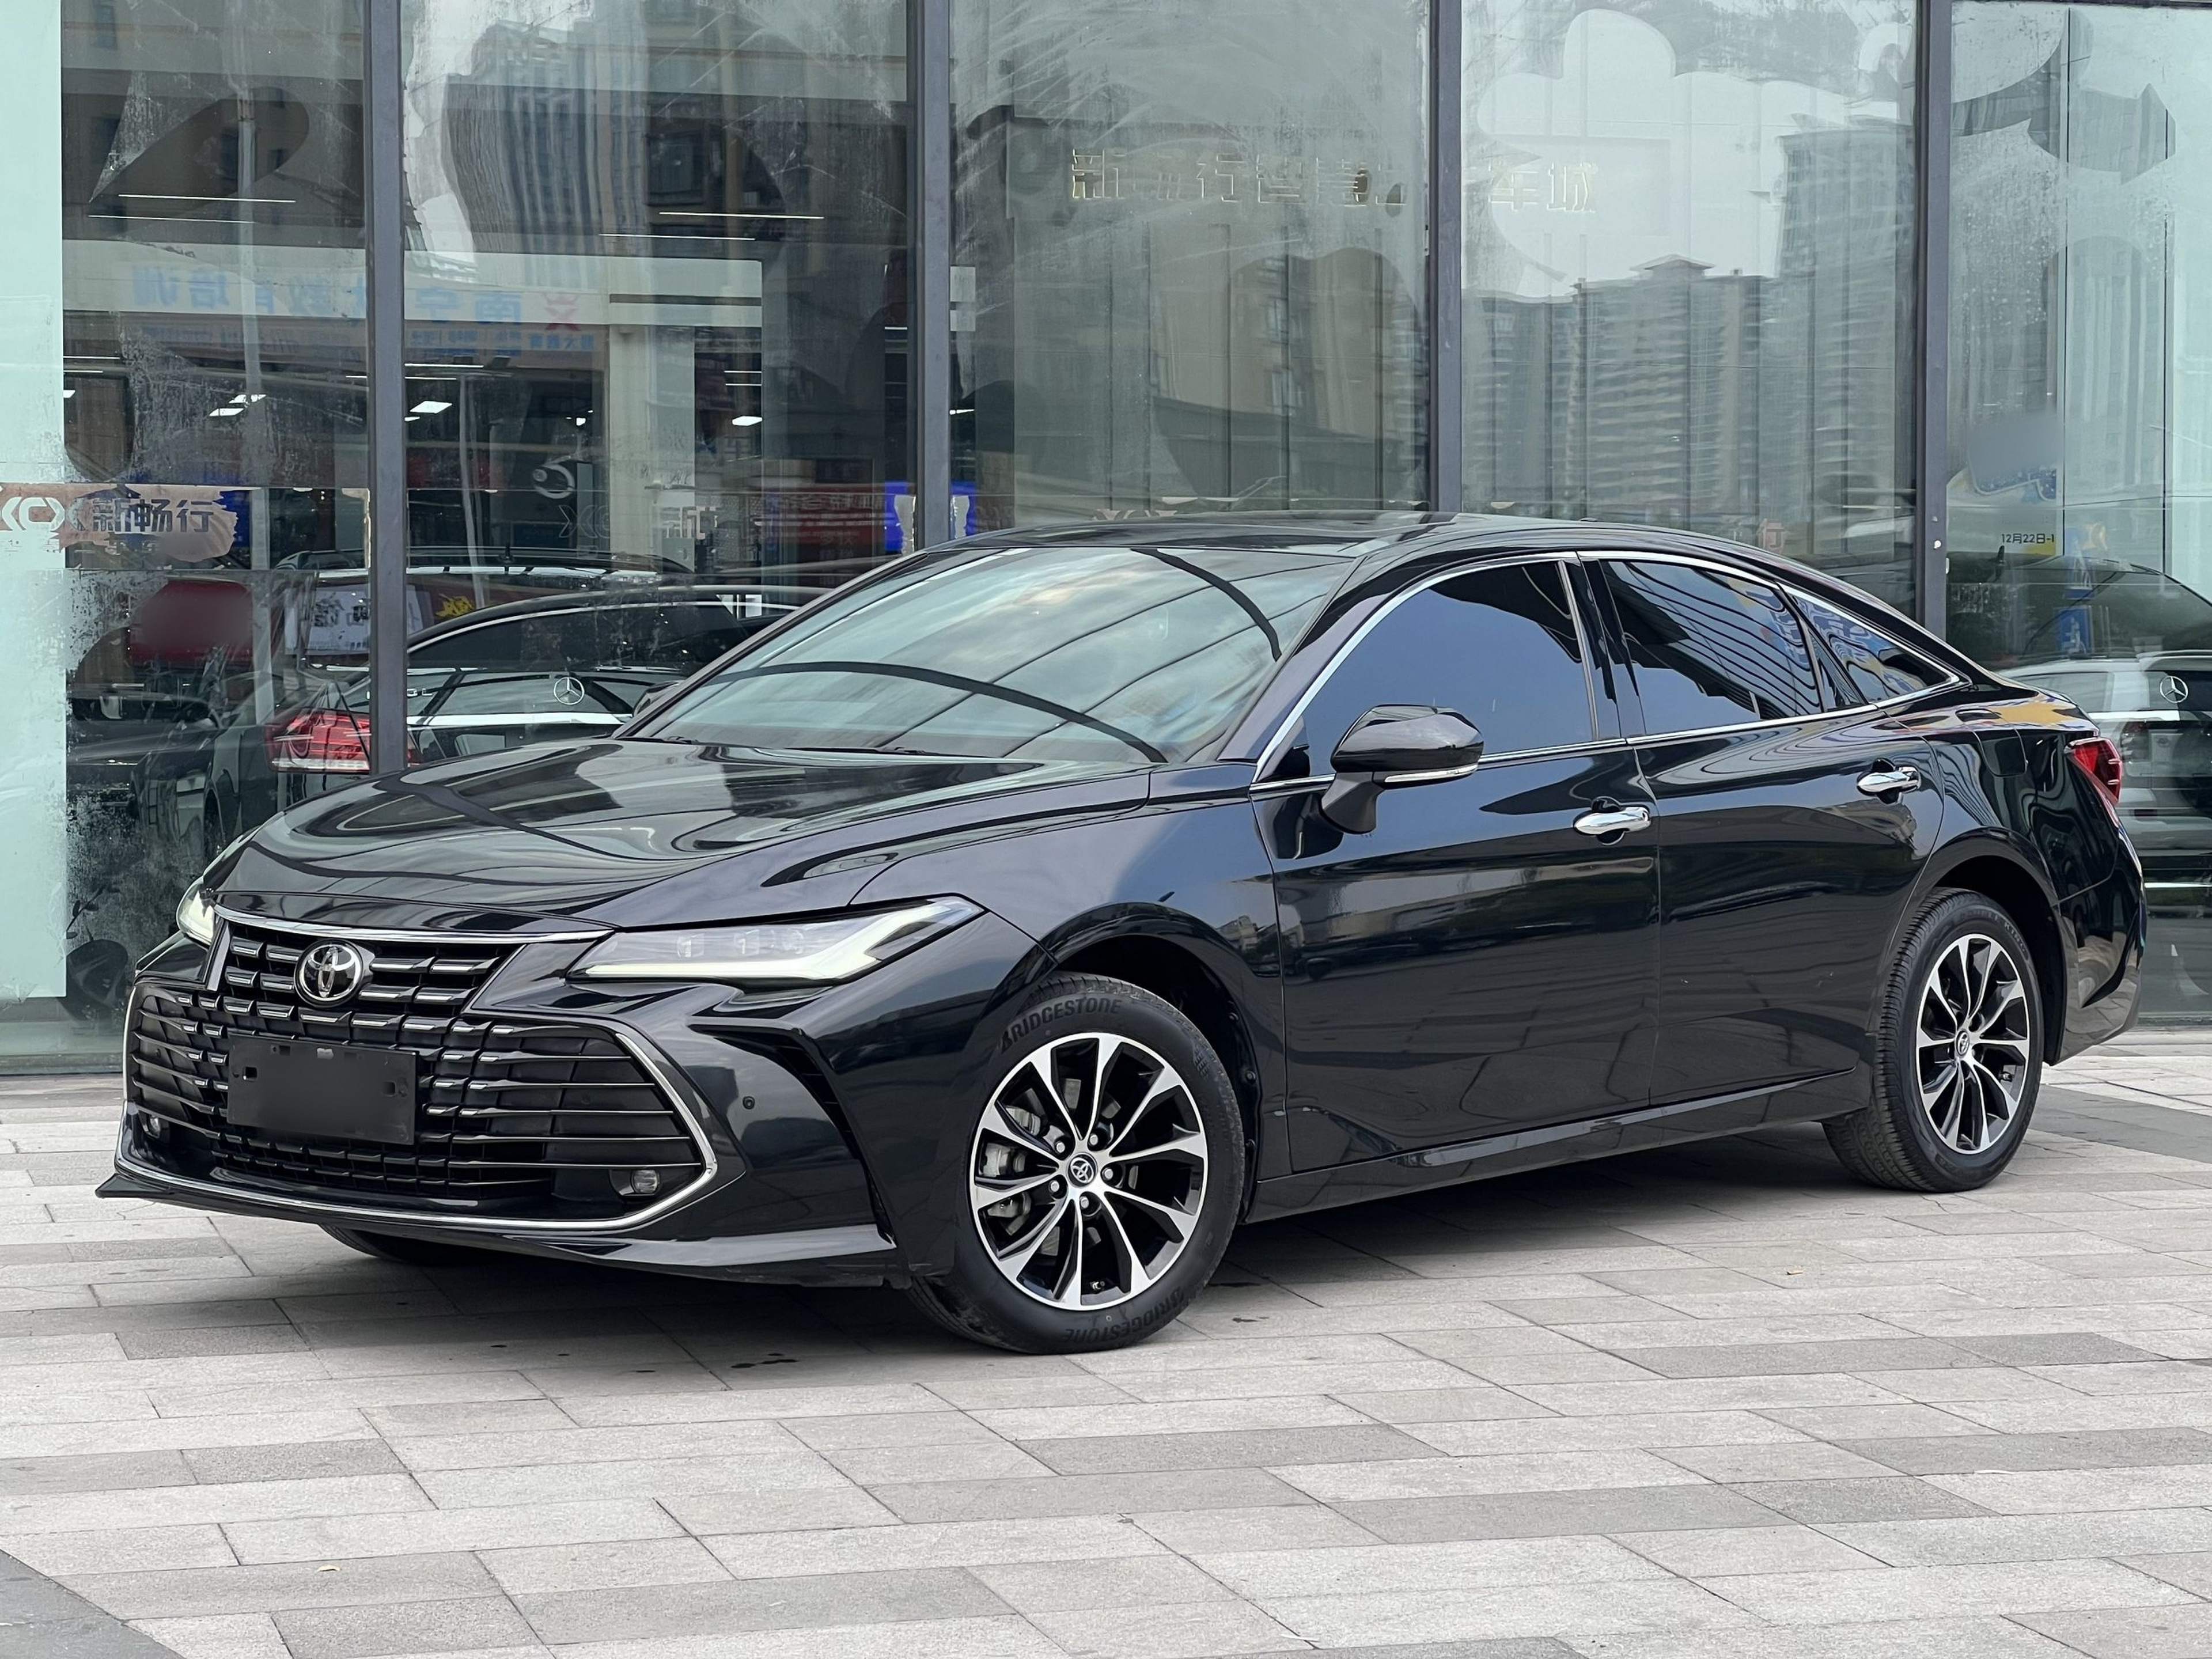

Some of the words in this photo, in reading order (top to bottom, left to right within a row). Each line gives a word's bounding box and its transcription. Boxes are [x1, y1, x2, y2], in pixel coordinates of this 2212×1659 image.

[93, 499, 214, 532] 新畅行
[1001, 997, 1122, 1054] BRIDGESTONE
[1063, 1286, 1184, 1343] BRIDGESTONE
